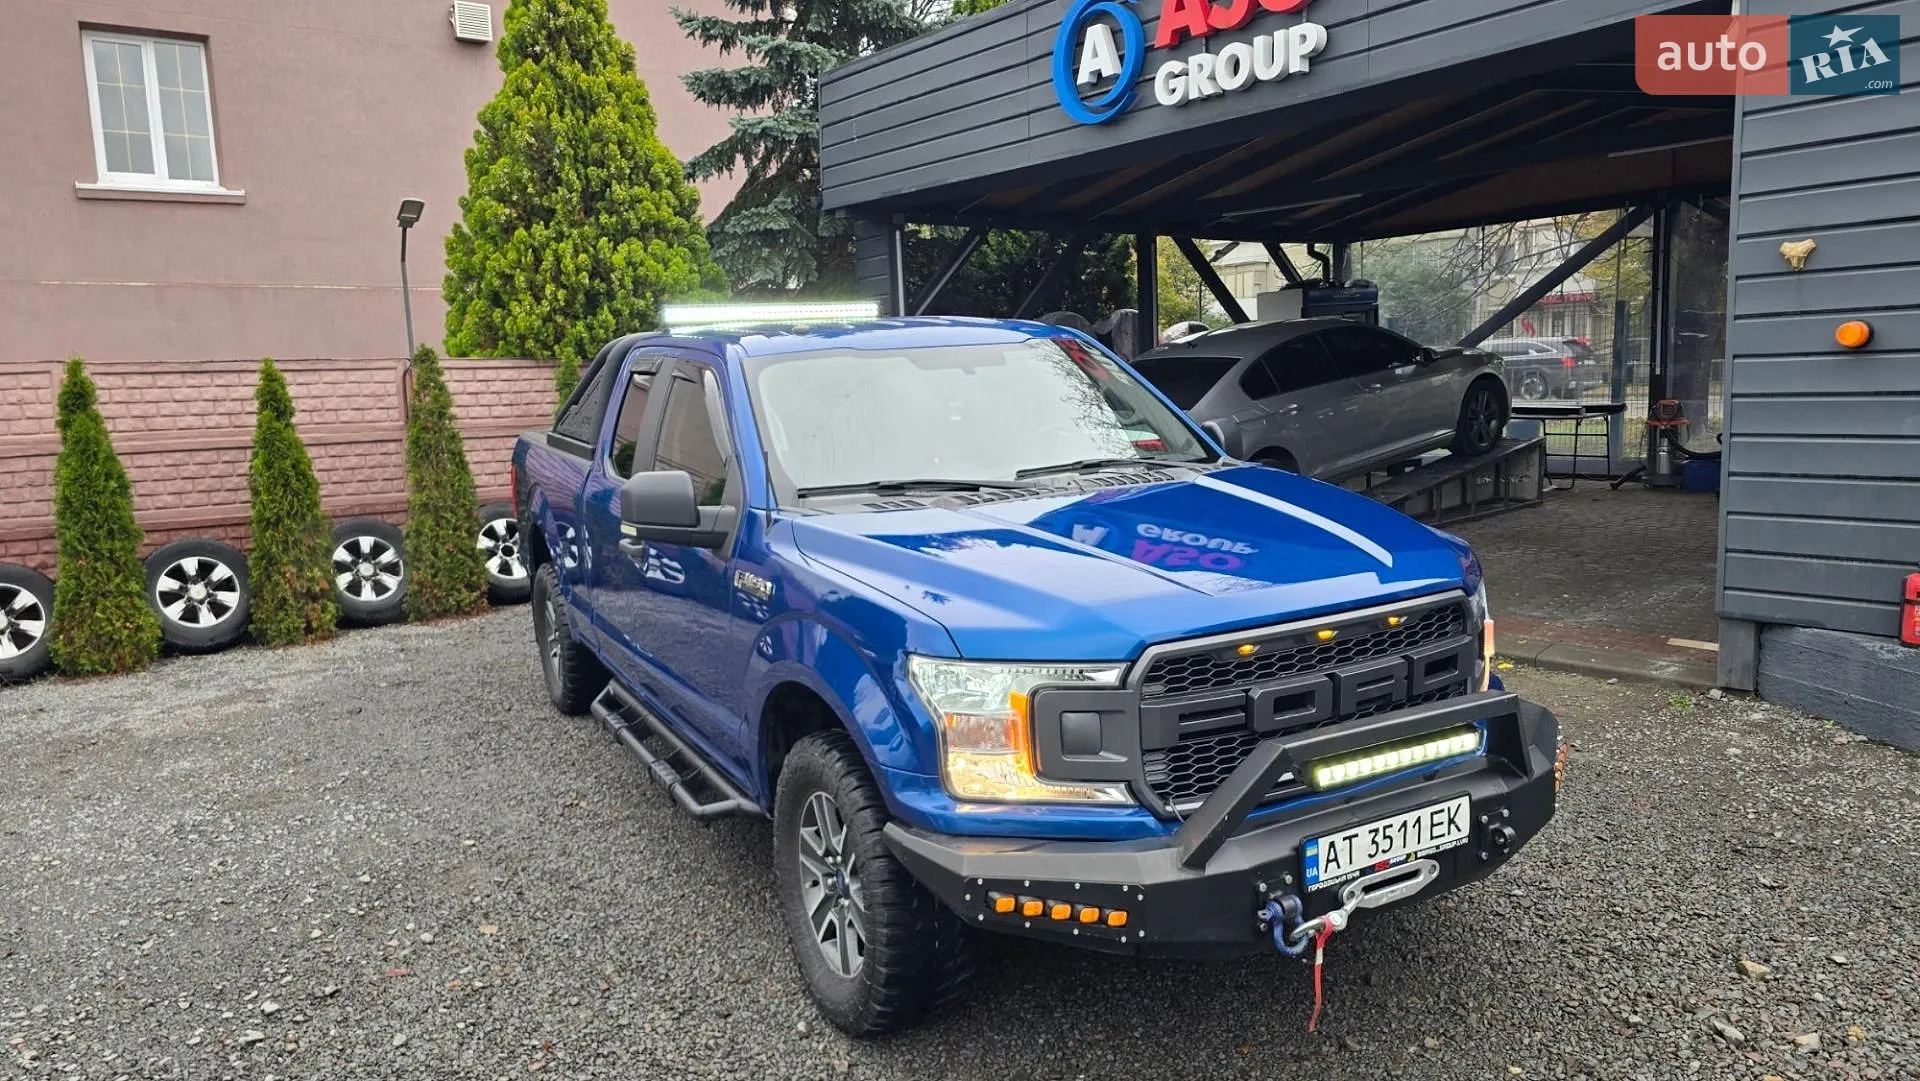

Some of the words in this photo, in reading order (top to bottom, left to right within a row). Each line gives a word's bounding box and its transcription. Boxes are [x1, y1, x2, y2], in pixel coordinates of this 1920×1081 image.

[1076, 23, 1122, 86] A
[1154, 22, 1328, 107] GROUP
[1140, 634, 1474, 750] FORD
[1305, 867, 1319, 879] UA
[1323, 833, 1359, 874] AT
[1367, 815, 1422, 859] 3511
[1430, 803, 1463, 841] EK
